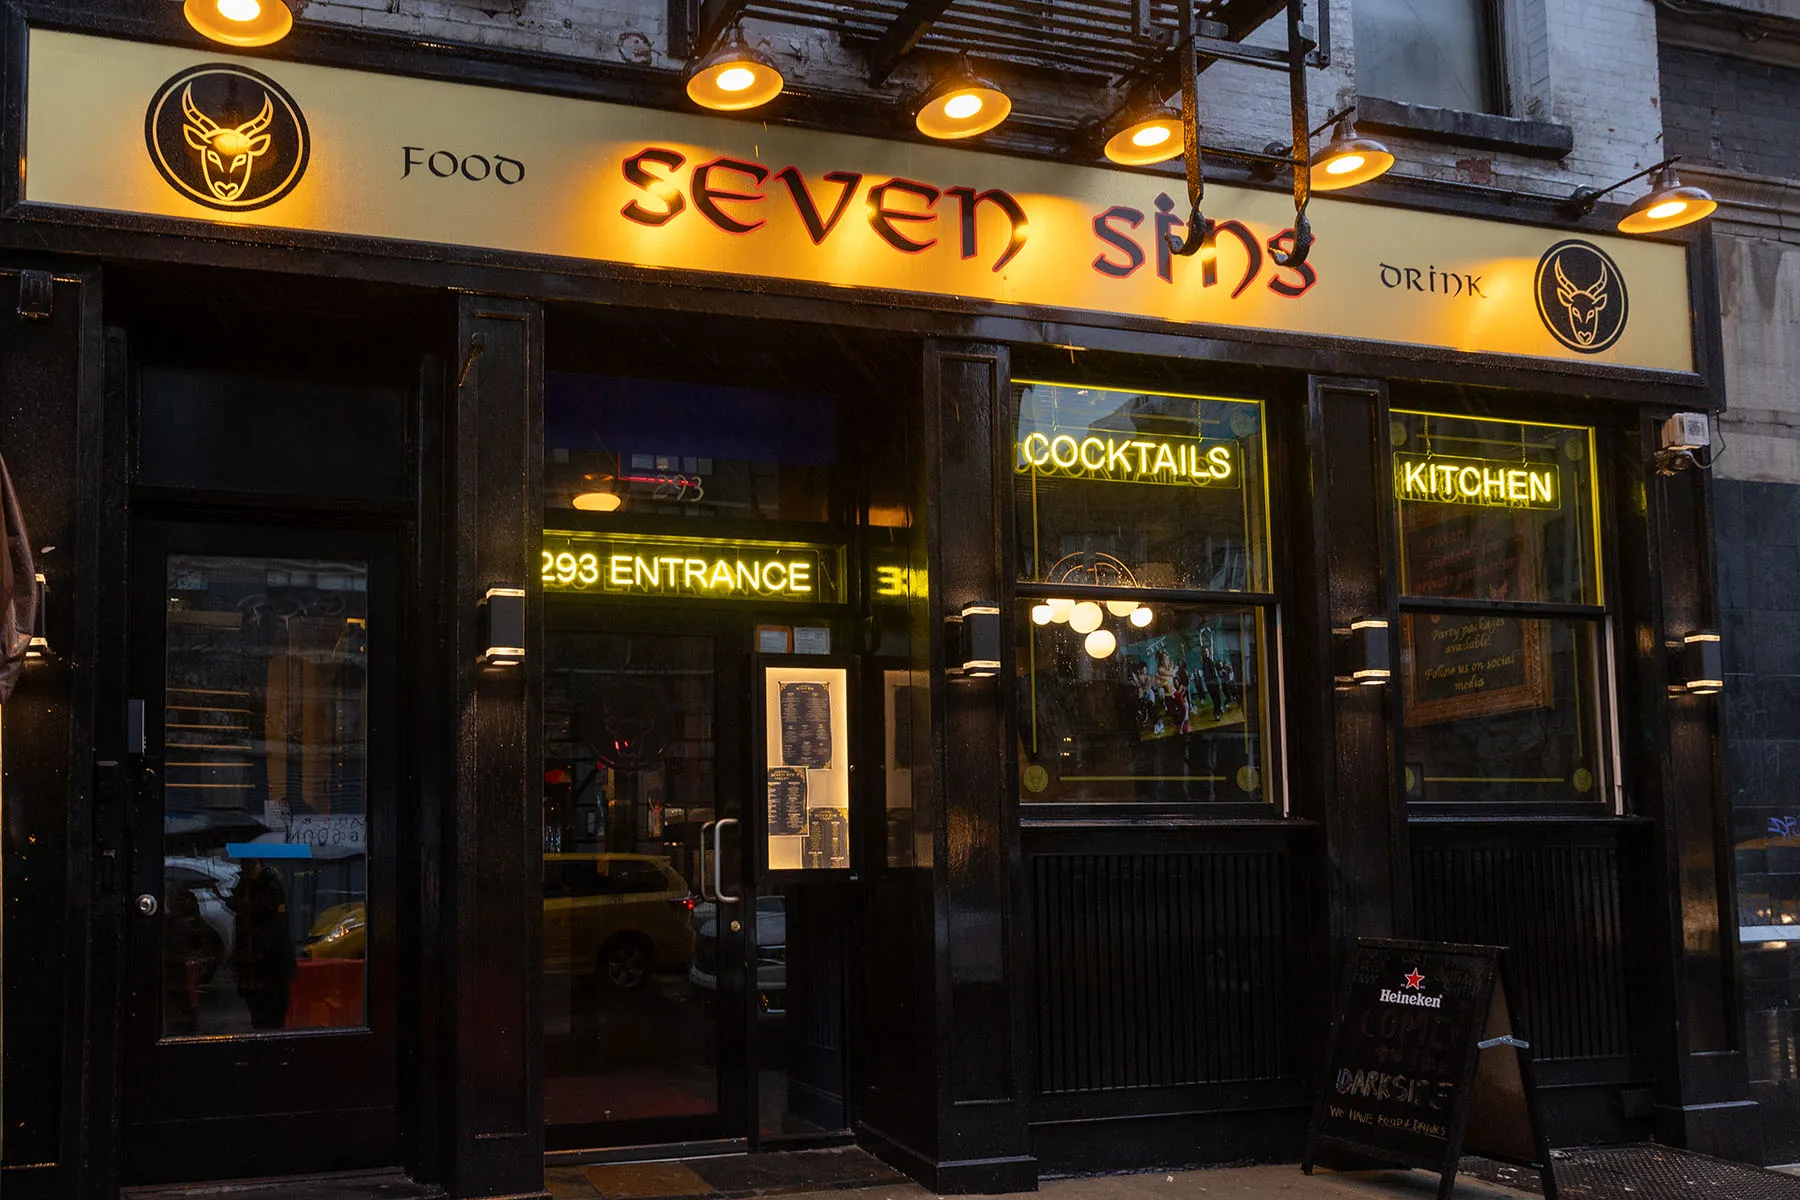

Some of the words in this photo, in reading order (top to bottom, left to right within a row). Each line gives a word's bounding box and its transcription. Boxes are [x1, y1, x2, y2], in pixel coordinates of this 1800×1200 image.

[400, 145, 526, 186] FOOD
[620, 147, 1030, 272] SEVEN
[1379, 262, 1489, 299] DRINK
[1024, 432, 1231, 479] COCKTAILS
[653, 474, 704, 502] 293
[1404, 461, 1553, 502] KITCHEN
[542, 551, 599, 584] 293
[611, 556, 811, 592] ENTRANCE
[1431, 627, 1459, 642] Party
[1379, 988, 1442, 1008] Heineken
